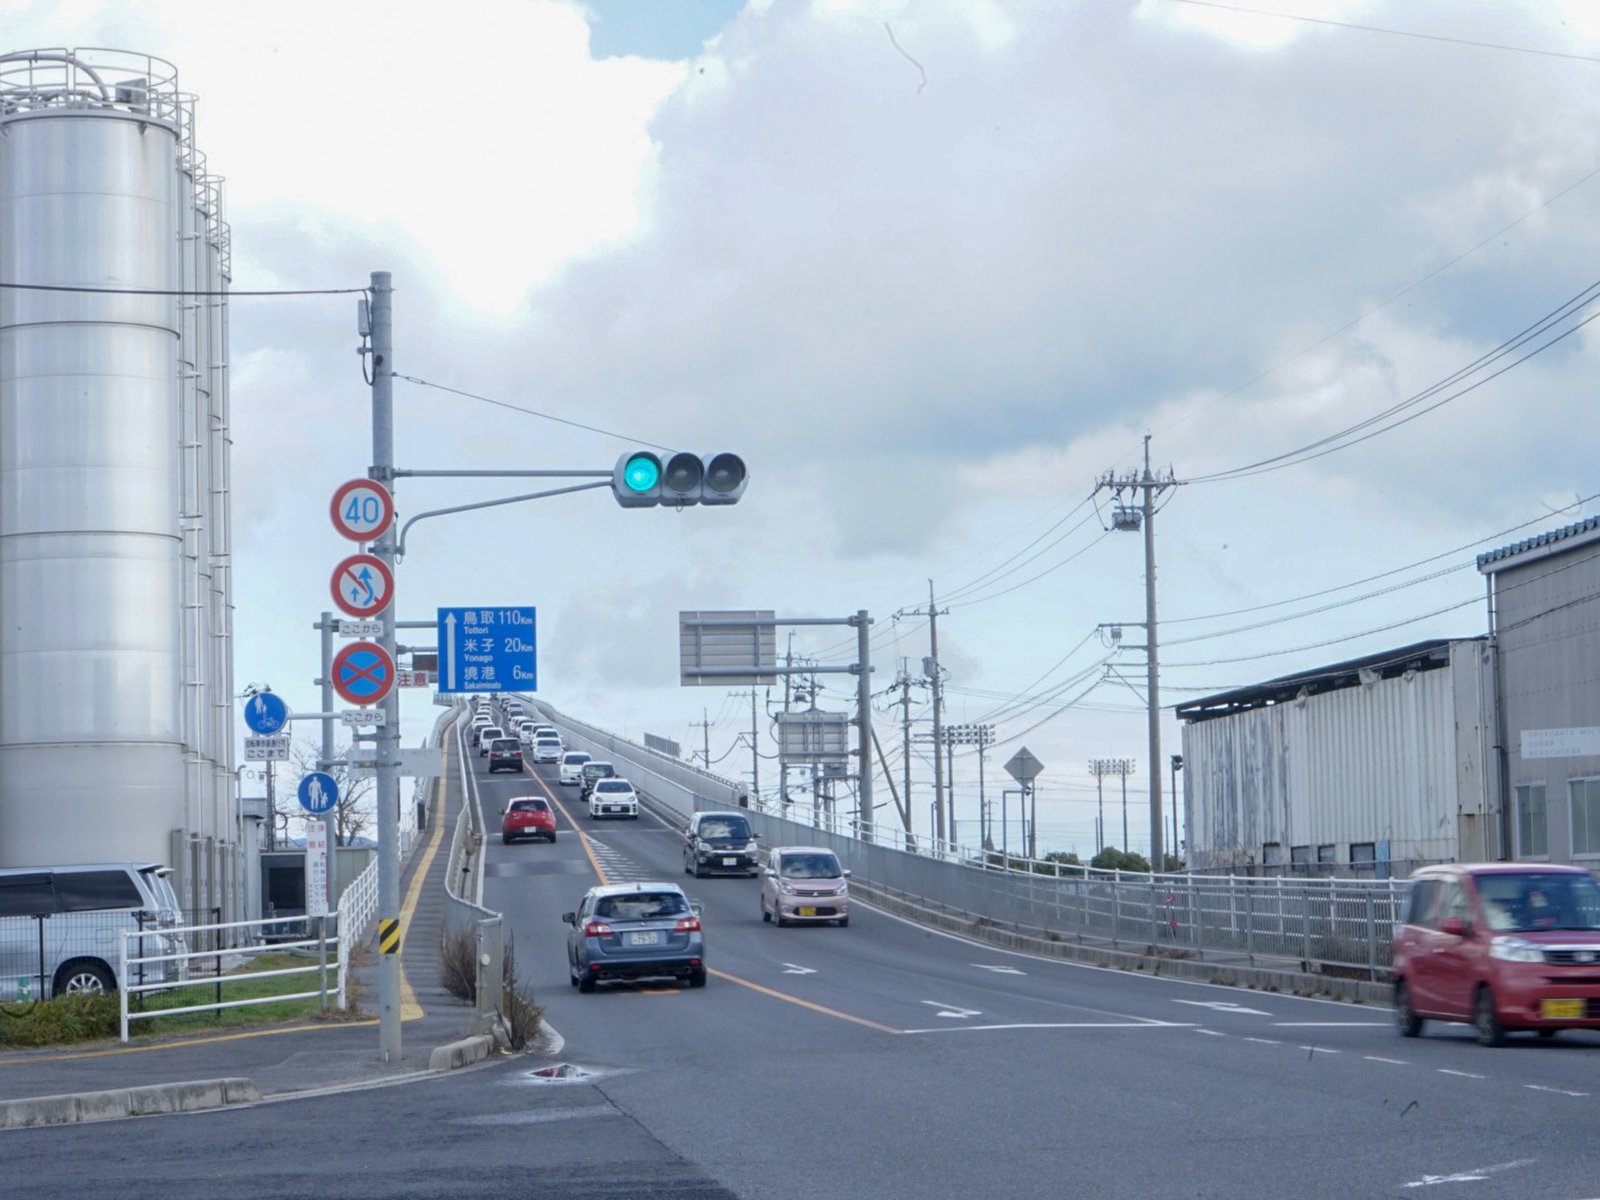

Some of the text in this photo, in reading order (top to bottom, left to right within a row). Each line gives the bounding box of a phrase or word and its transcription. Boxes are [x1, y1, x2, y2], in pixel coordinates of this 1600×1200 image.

[345, 496, 379, 524] 40
[463, 610, 495, 625] 鳥取
[342, 623, 381, 634] ここから
[463, 627, 488, 635] Tottori
[463, 638, 495, 653] 米子
[463, 654, 493, 663] Yonago
[463, 666, 495, 680] 境港
[396, 672, 427, 687] 注意
[344, 712, 383, 723] ここから
[246, 749, 285, 759] ここまで
